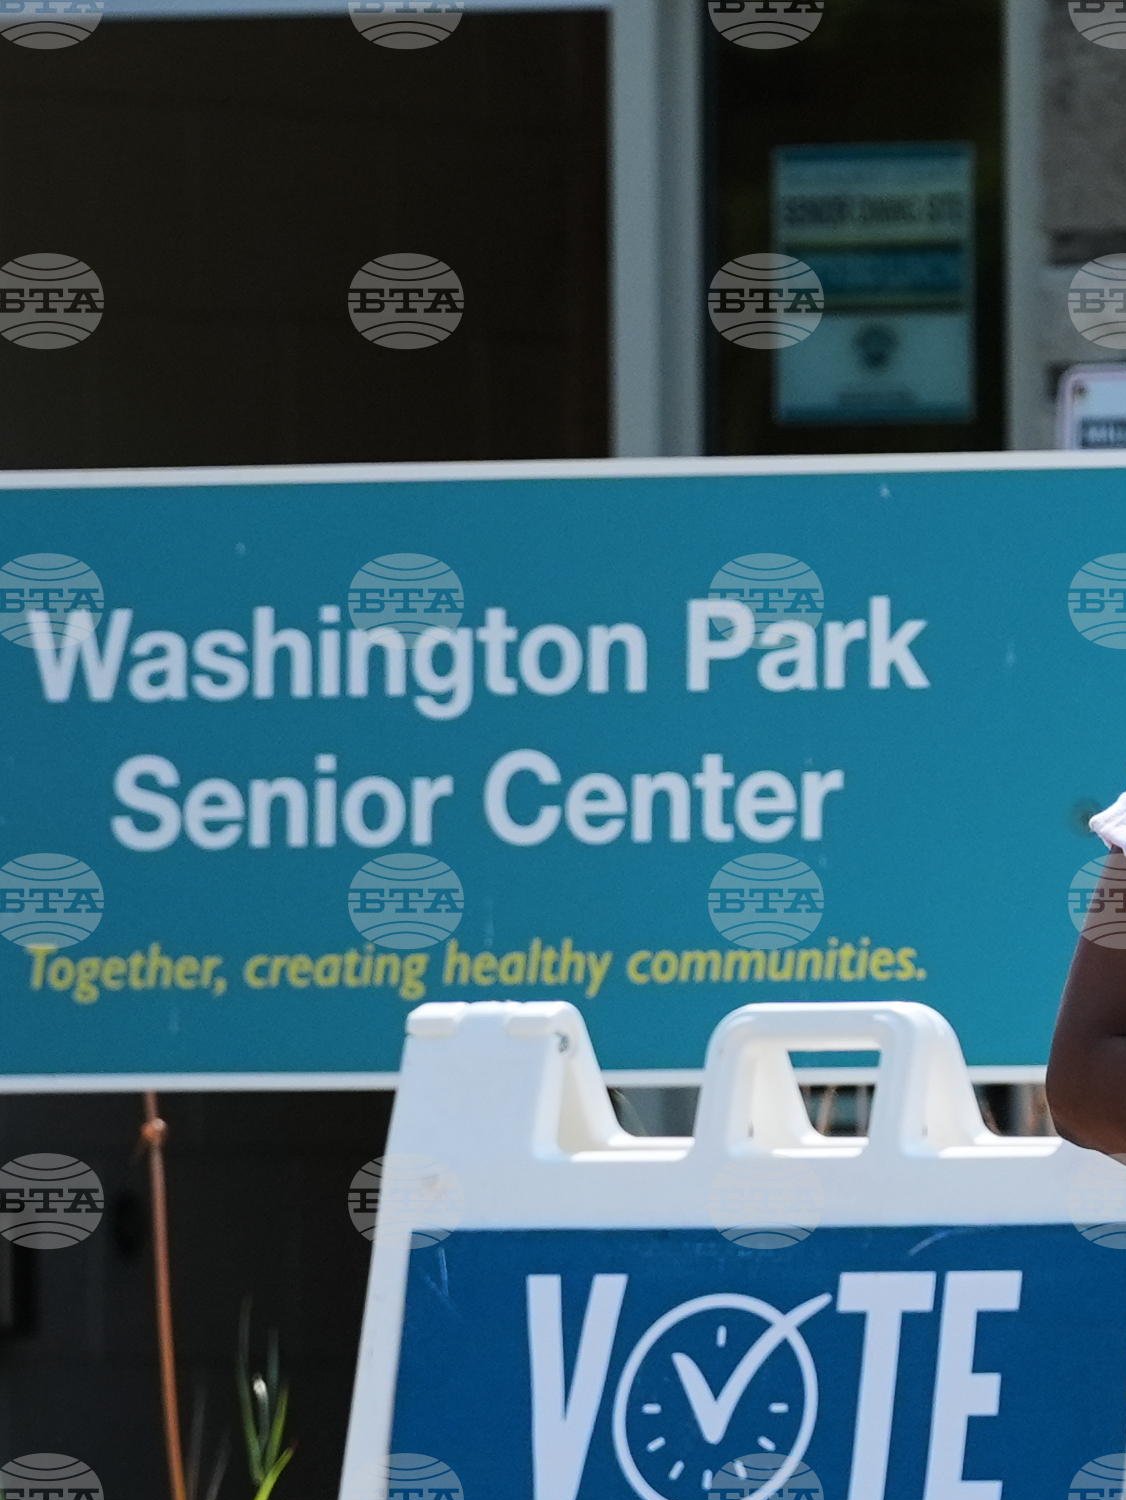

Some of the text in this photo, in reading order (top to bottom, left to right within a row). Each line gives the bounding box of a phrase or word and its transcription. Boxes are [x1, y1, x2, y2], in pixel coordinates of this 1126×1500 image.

[27, 596, 931, 720] Washington Park
[111, 749, 844, 851] Senior Center
[26, 936, 928, 1003] Together, creating healthy communities.
